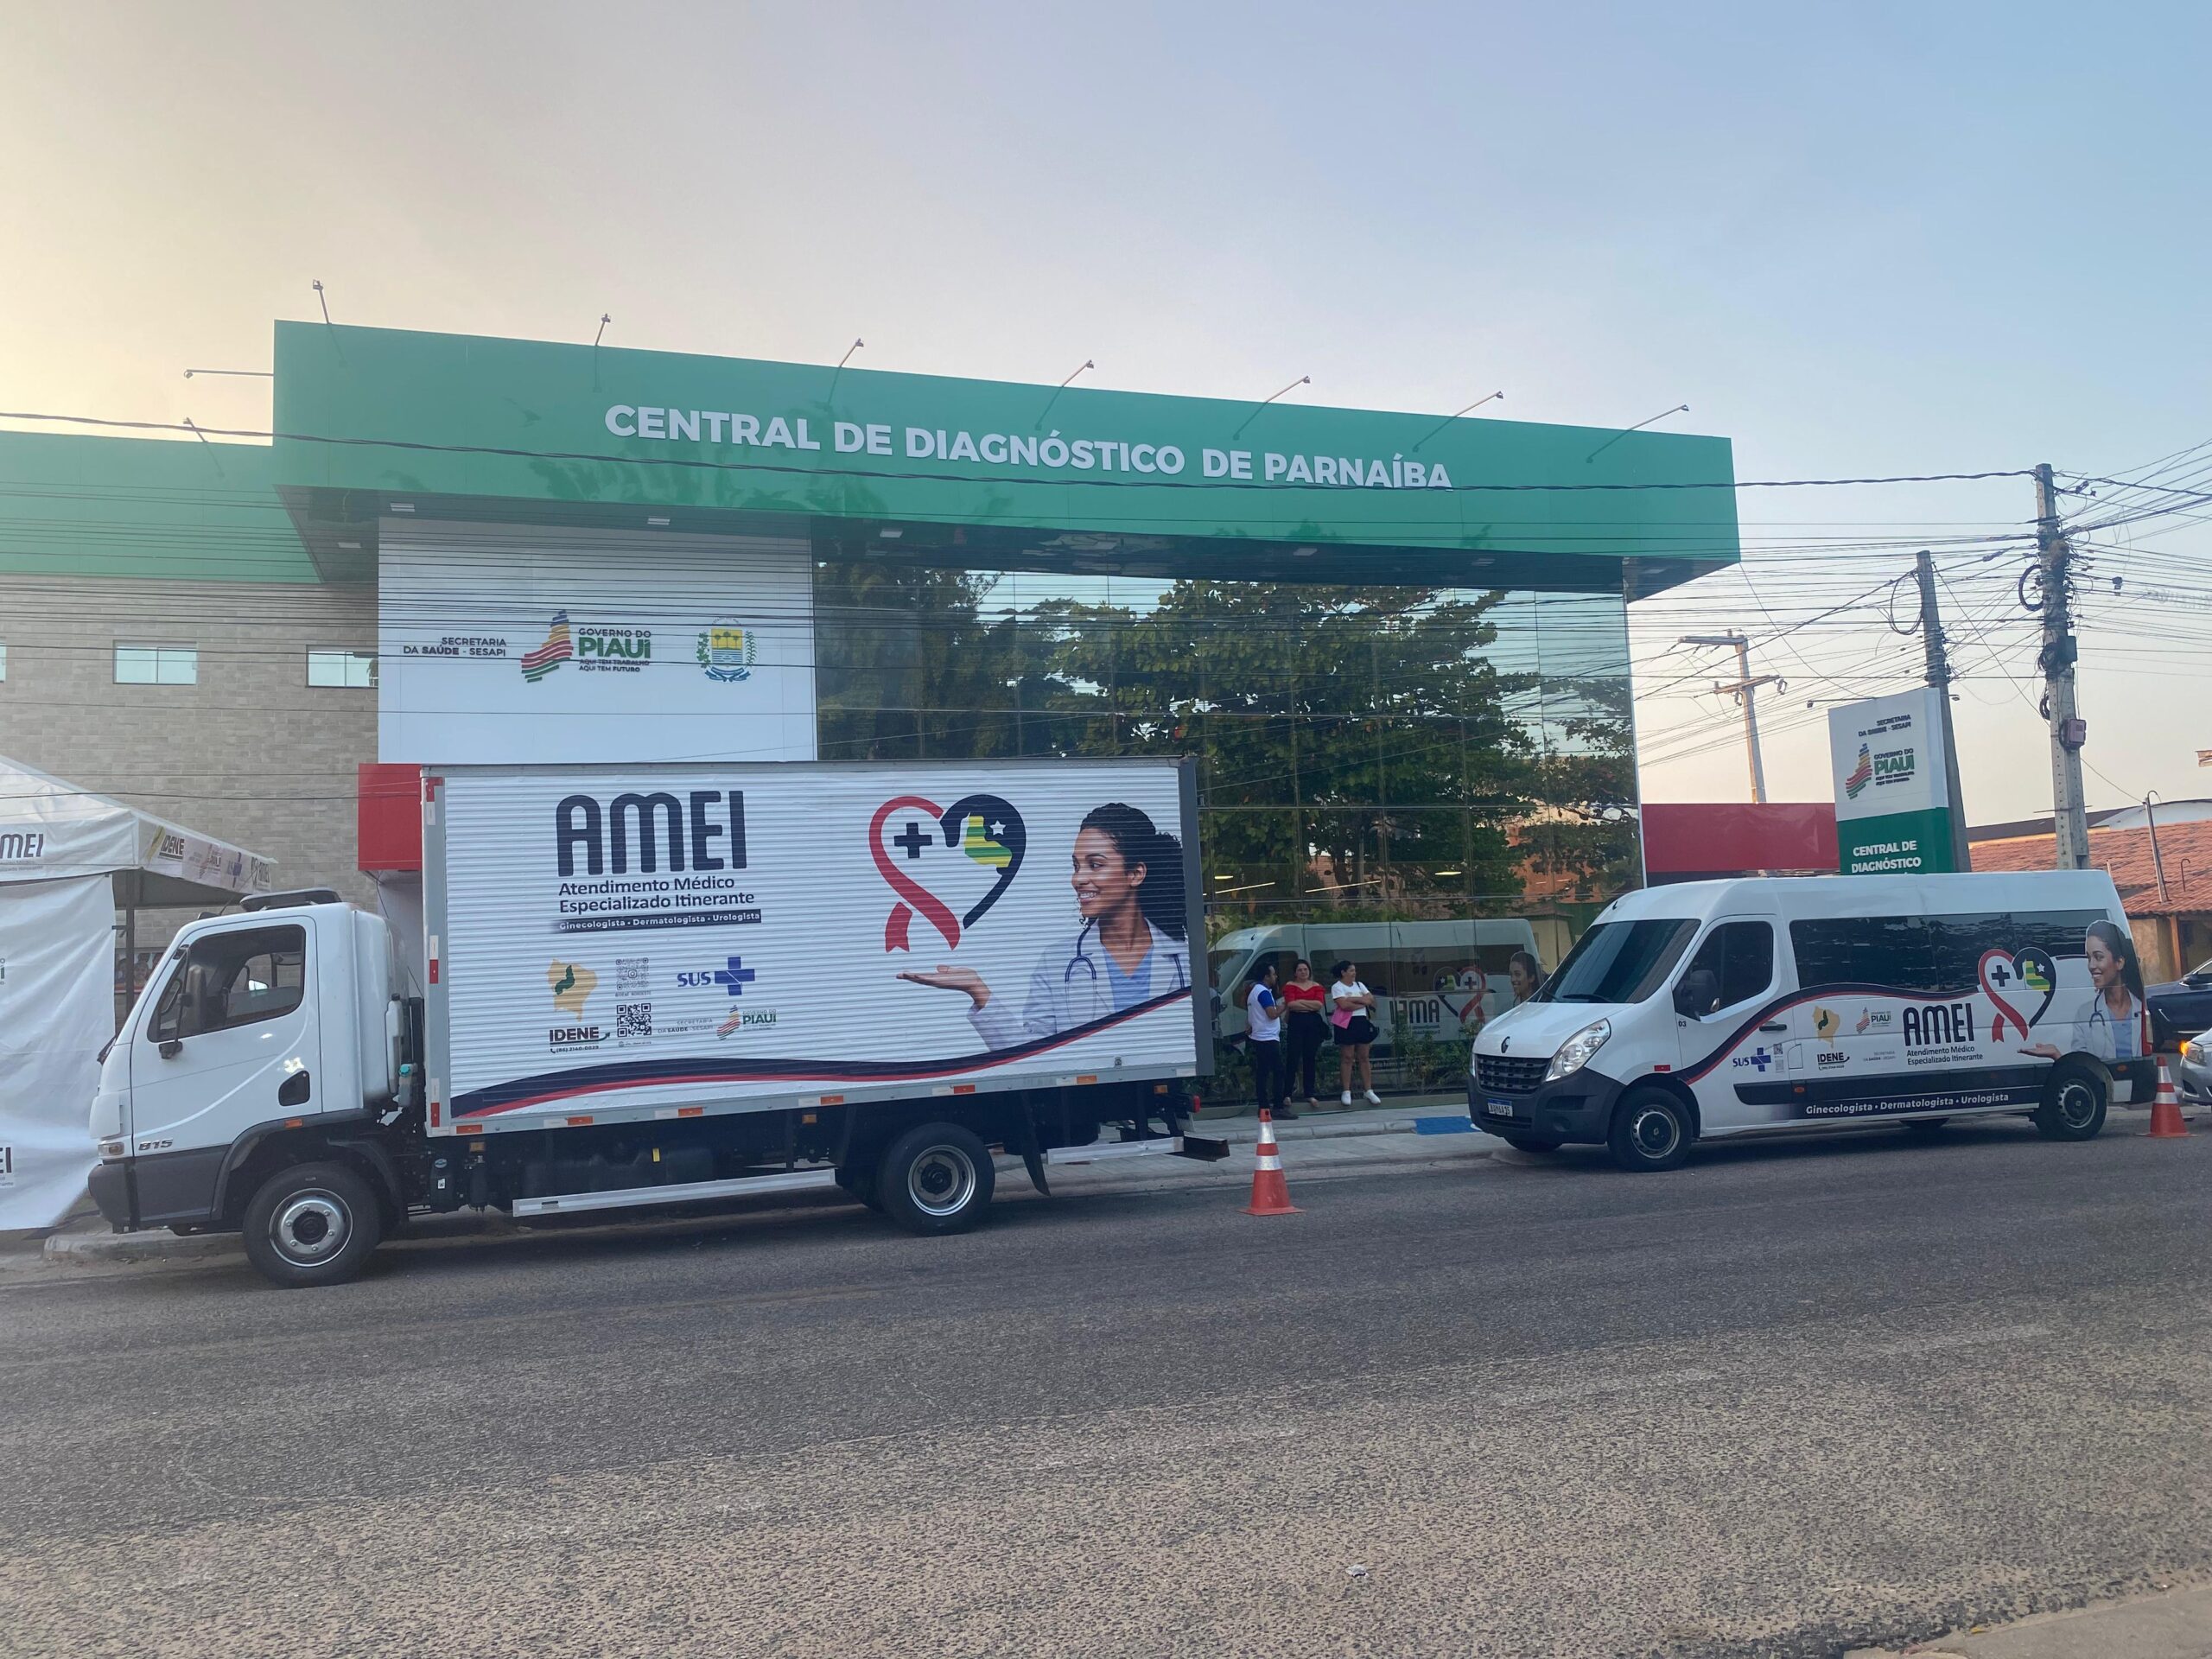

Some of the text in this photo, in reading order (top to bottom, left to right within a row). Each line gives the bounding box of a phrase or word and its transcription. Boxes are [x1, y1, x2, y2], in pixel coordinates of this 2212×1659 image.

[605, 404, 1454, 492] CENTRAL DE DIAGNÓSTICO DE PARNAÍBA
[579, 627, 652, 639] GOVERNO DO
[442, 637, 506, 646] SECRETARIA
[403, 645, 419, 654] DA
[422, 644, 460, 656] SAÚDE
[469, 647, 506, 657] SESAPI
[1877, 714, 1911, 726] SECRETARIA
[1873, 750, 1903, 760] GOVERNO
[556, 790, 747, 877] AMEI
[1853, 840, 1917, 856] CENTRAL DE
[1852, 857, 1922, 874] DIAGNÓSTICO
[558, 875, 734, 896] Atendimento Médico
[560, 892, 754, 915] Especializado Itinerante
[560, 912, 760, 931] Ginecologista Dermatologista Urologista
[677, 971, 711, 987] SUS
[1903, 1002, 1974, 1046] AMEI
[550, 1027, 600, 1042] IDENE
[1817, 1052, 1845, 1063] IDENE
[1907, 1047, 1949, 1057] Atendimento
[1950, 1045, 1975, 1053] Médico
[1732, 1057, 1750, 1067] SUS
[1907, 1055, 1951, 1066] Especializado
[1952, 1053, 1984, 1062] Itinerante
[1806, 1093, 2009, 1115] Ginecologista Dermatologista Urologista
